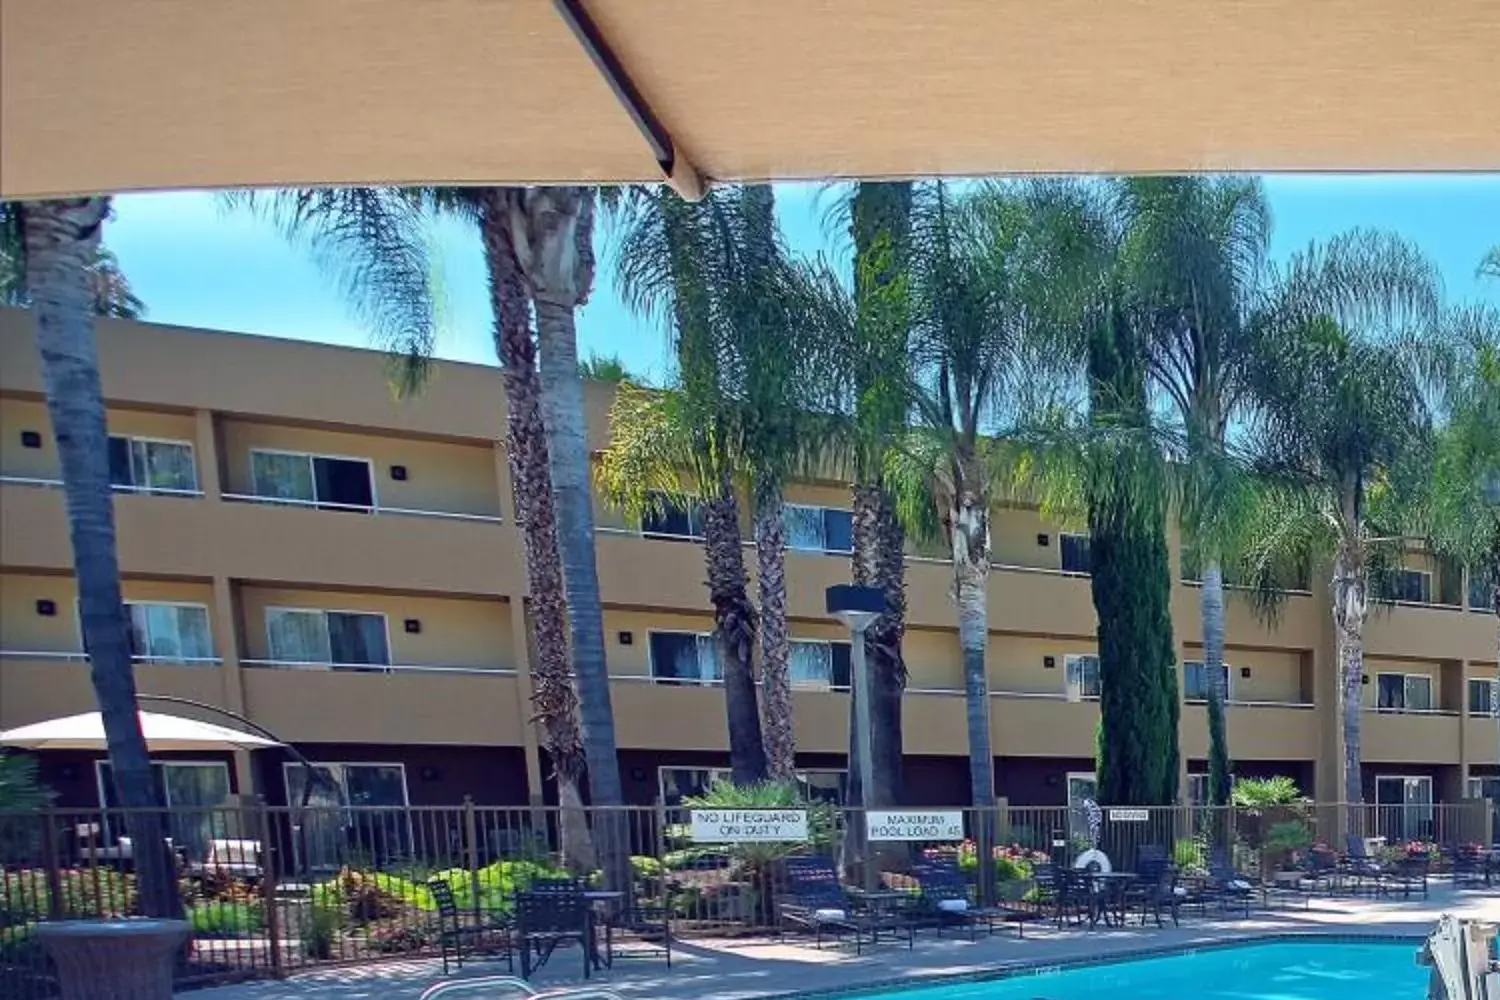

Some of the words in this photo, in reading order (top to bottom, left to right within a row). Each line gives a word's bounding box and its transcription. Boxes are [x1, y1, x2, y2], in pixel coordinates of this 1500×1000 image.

[697, 812, 720, 823] NO
[723, 813, 801, 824] LIFEGUARD
[887, 815, 945, 825] MAXIMUM
[719, 825, 740, 835] ON
[744, 825, 781, 836] DUTY
[872, 825, 904, 836] POOL
[907, 825, 939, 837] LOAD
